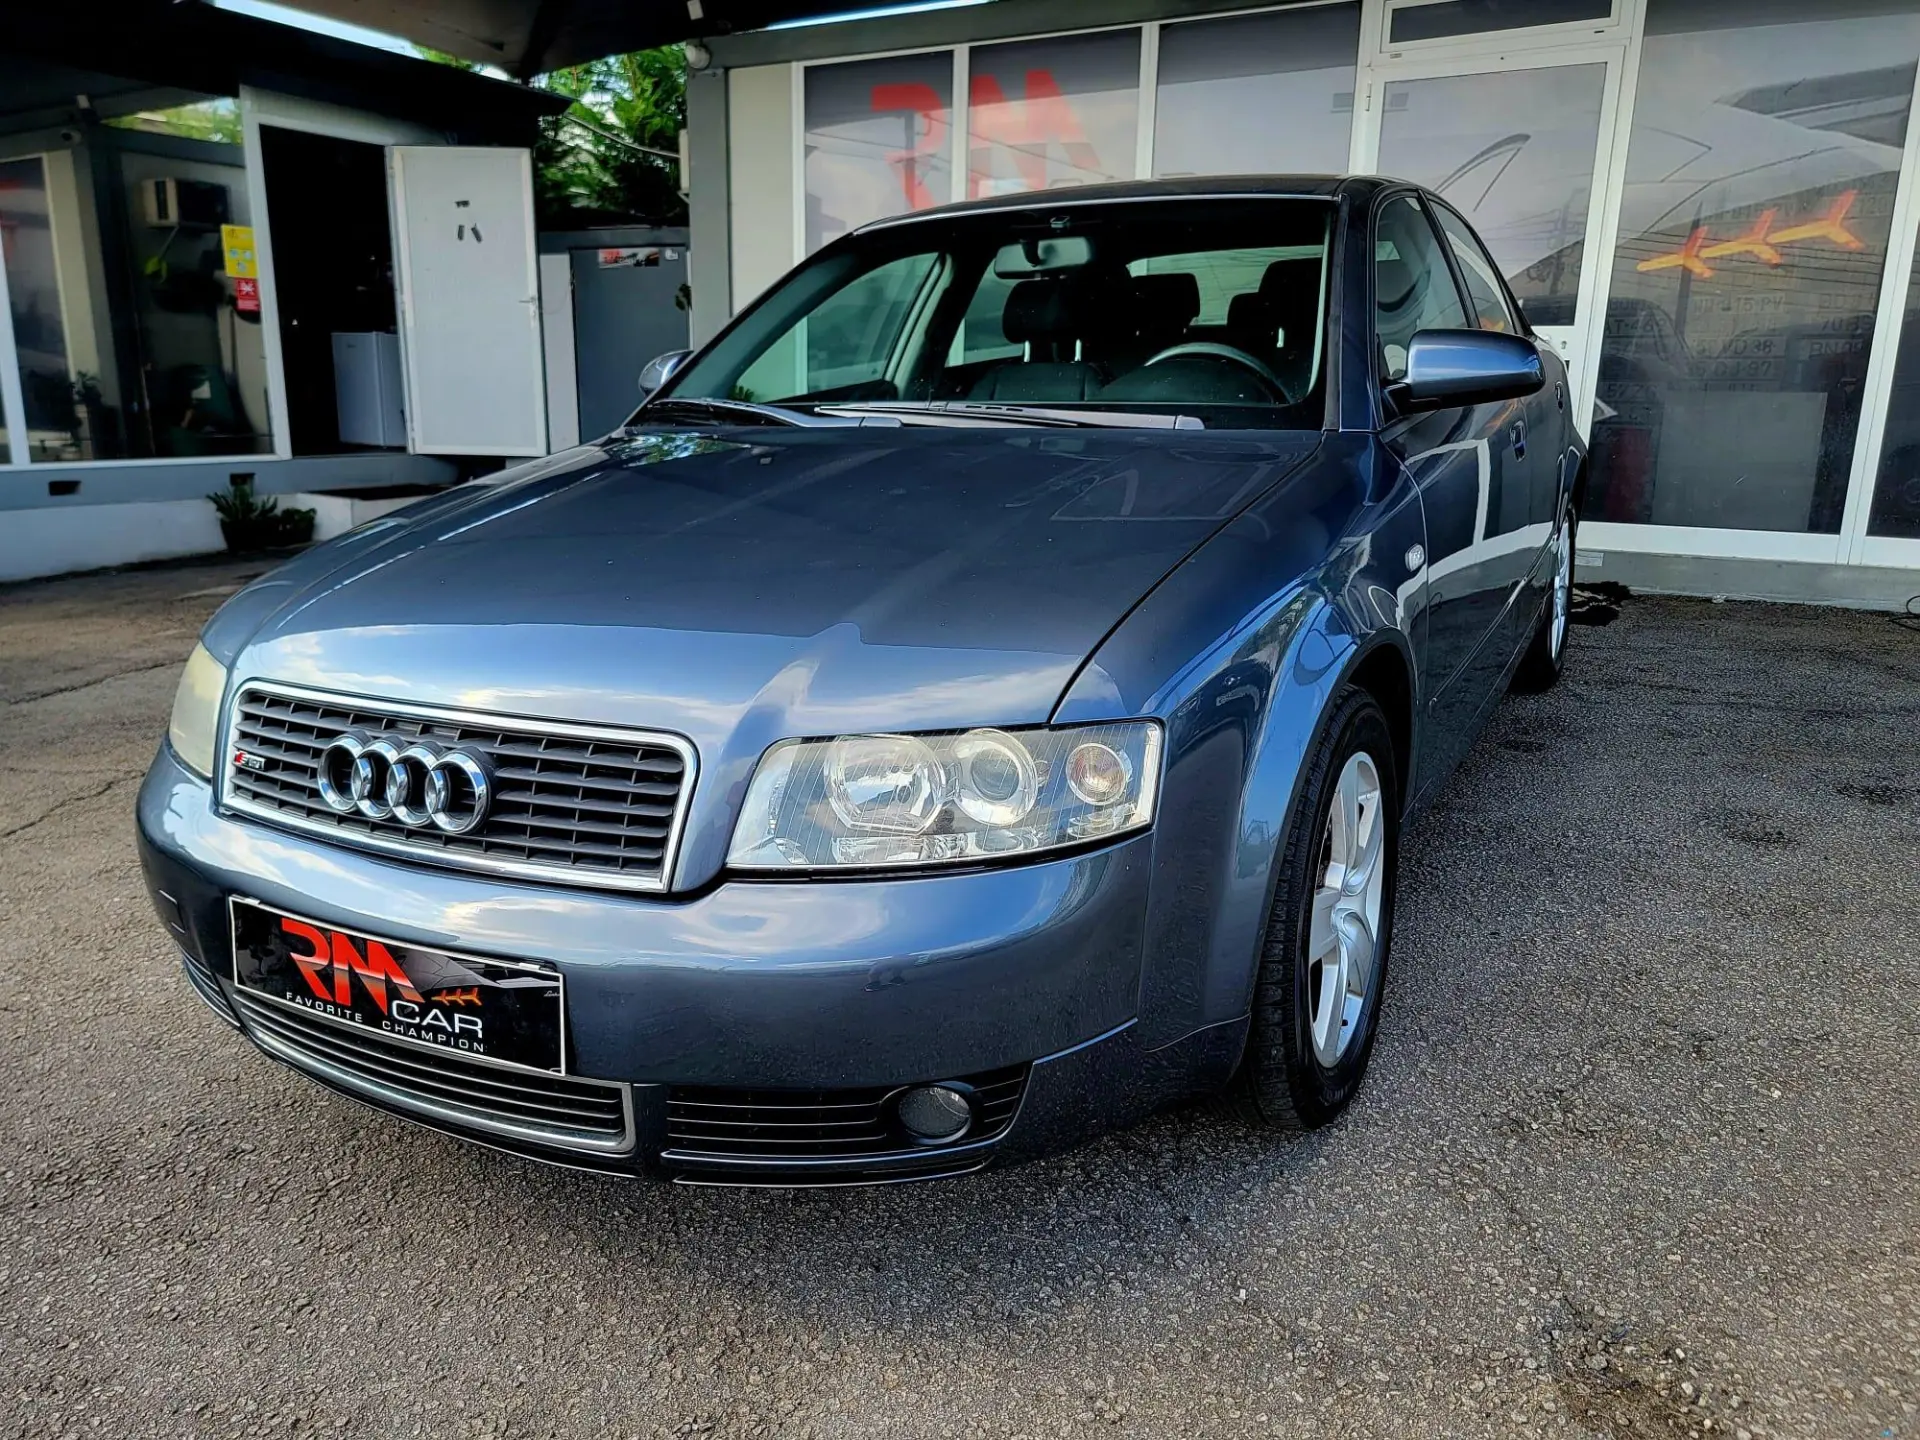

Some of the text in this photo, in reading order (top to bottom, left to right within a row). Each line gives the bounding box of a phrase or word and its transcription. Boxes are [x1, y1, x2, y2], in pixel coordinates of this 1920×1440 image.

[281, 918, 426, 1016] RM
[286, 992, 484, 1052] FAVORITE CHAMPION
[391, 1000, 484, 1039] CAR
